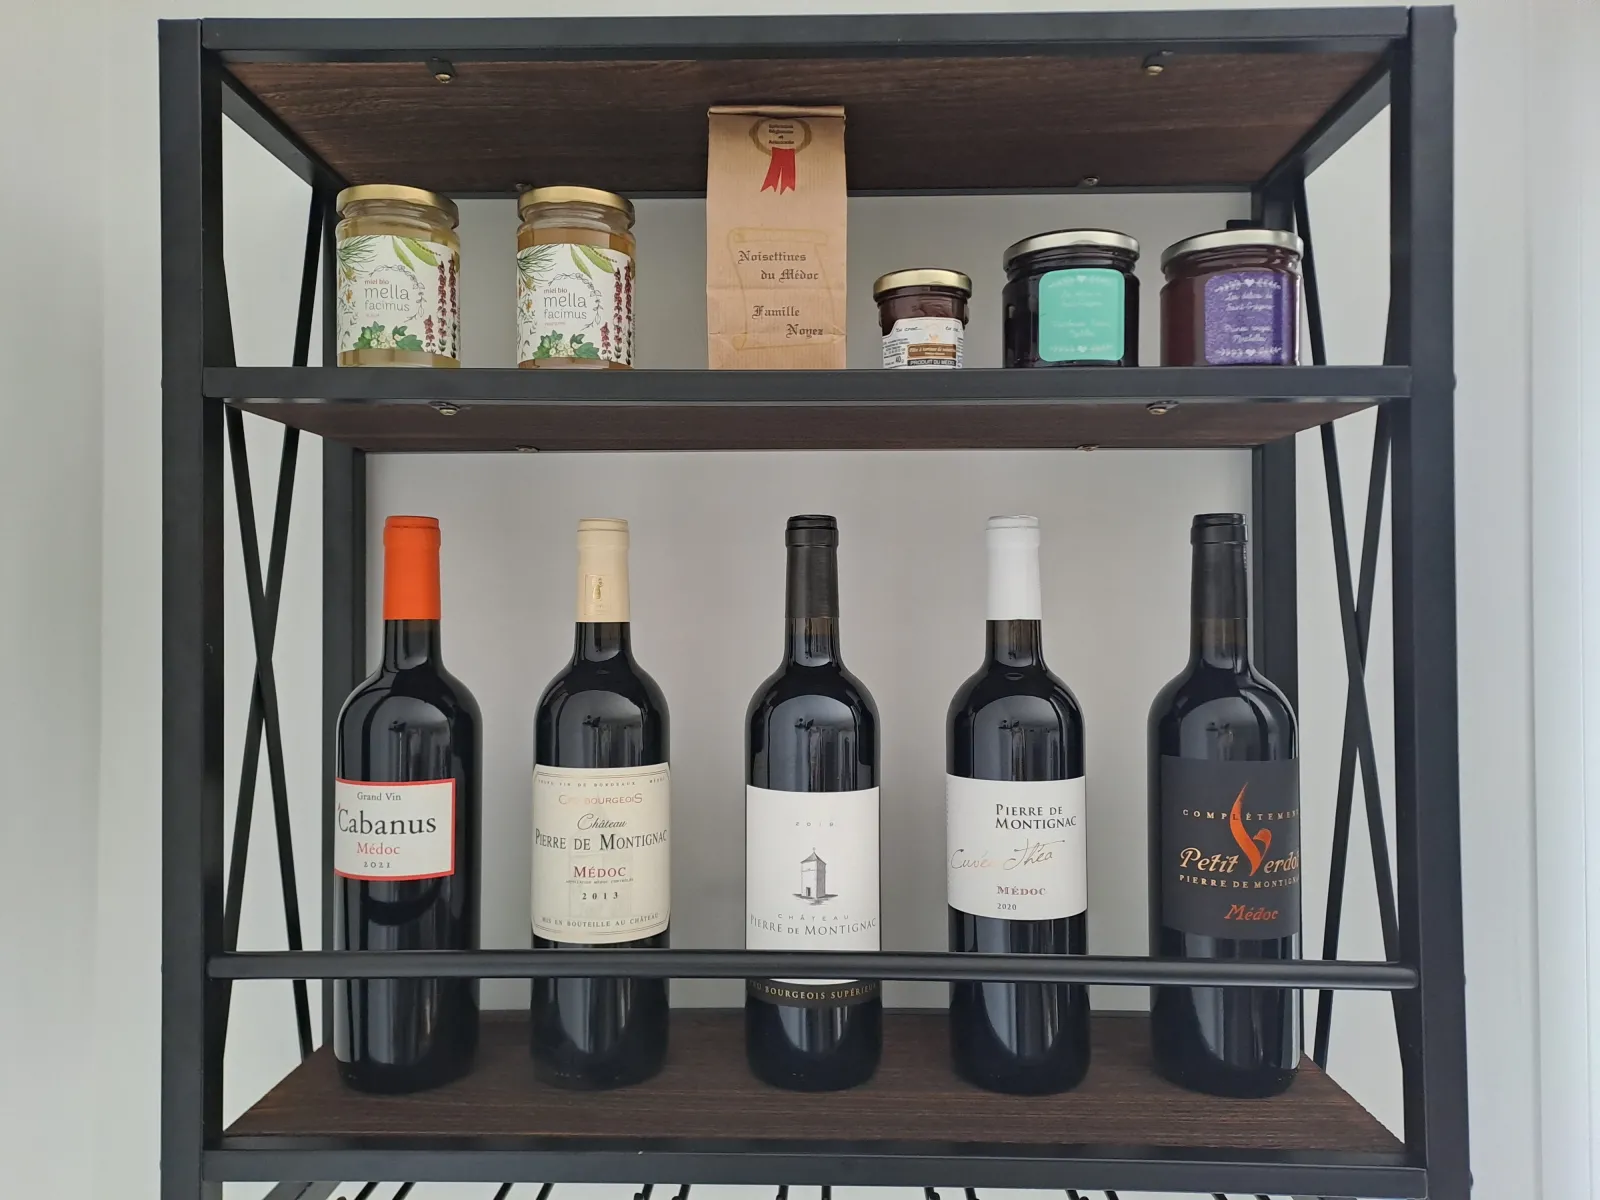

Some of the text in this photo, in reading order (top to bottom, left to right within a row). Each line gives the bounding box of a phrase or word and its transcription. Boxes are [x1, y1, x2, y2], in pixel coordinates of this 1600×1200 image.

[738, 250, 806, 264] Noisettines
[761, 268, 819, 283] du Médoc
[364, 284, 409, 300] mella
[364, 300, 410, 311] facimus
[544, 292, 587, 308] mella
[544, 308, 587, 320] facimus
[752, 305, 800, 320] Famille
[786, 323, 824, 338] Noyez
[356, 792, 382, 801] Grand
[996, 804, 1063, 816] PIERRE DE
[338, 808, 436, 835] Cabanus
[577, 813, 627, 830] Château
[995, 816, 1077, 830] MONTIGNAC
[535, 828, 668, 851] PIERRE DE MONTIGNAC
[356, 842, 400, 855] Médoc
[1180, 847, 1240, 874] Petit
[573, 866, 626, 878] MÉDOC
[1180, 874, 1228, 888] PIERRE
[1232, 880, 1249, 888] DE
[582, 891, 618, 900] 2013
[996, 886, 1046, 896] MÉDOC
[997, 902, 1017, 910] 2020
[1224, 904, 1279, 920] Médoc
[630, 912, 659, 924] CHÂTEAU
[778, 912, 849, 921] CHÂTEAU
[750, 914, 782, 932] PIERRE
[804, 918, 876, 936] MONTIGNAC
[764, 985, 826, 1000] BOURGEOIS
